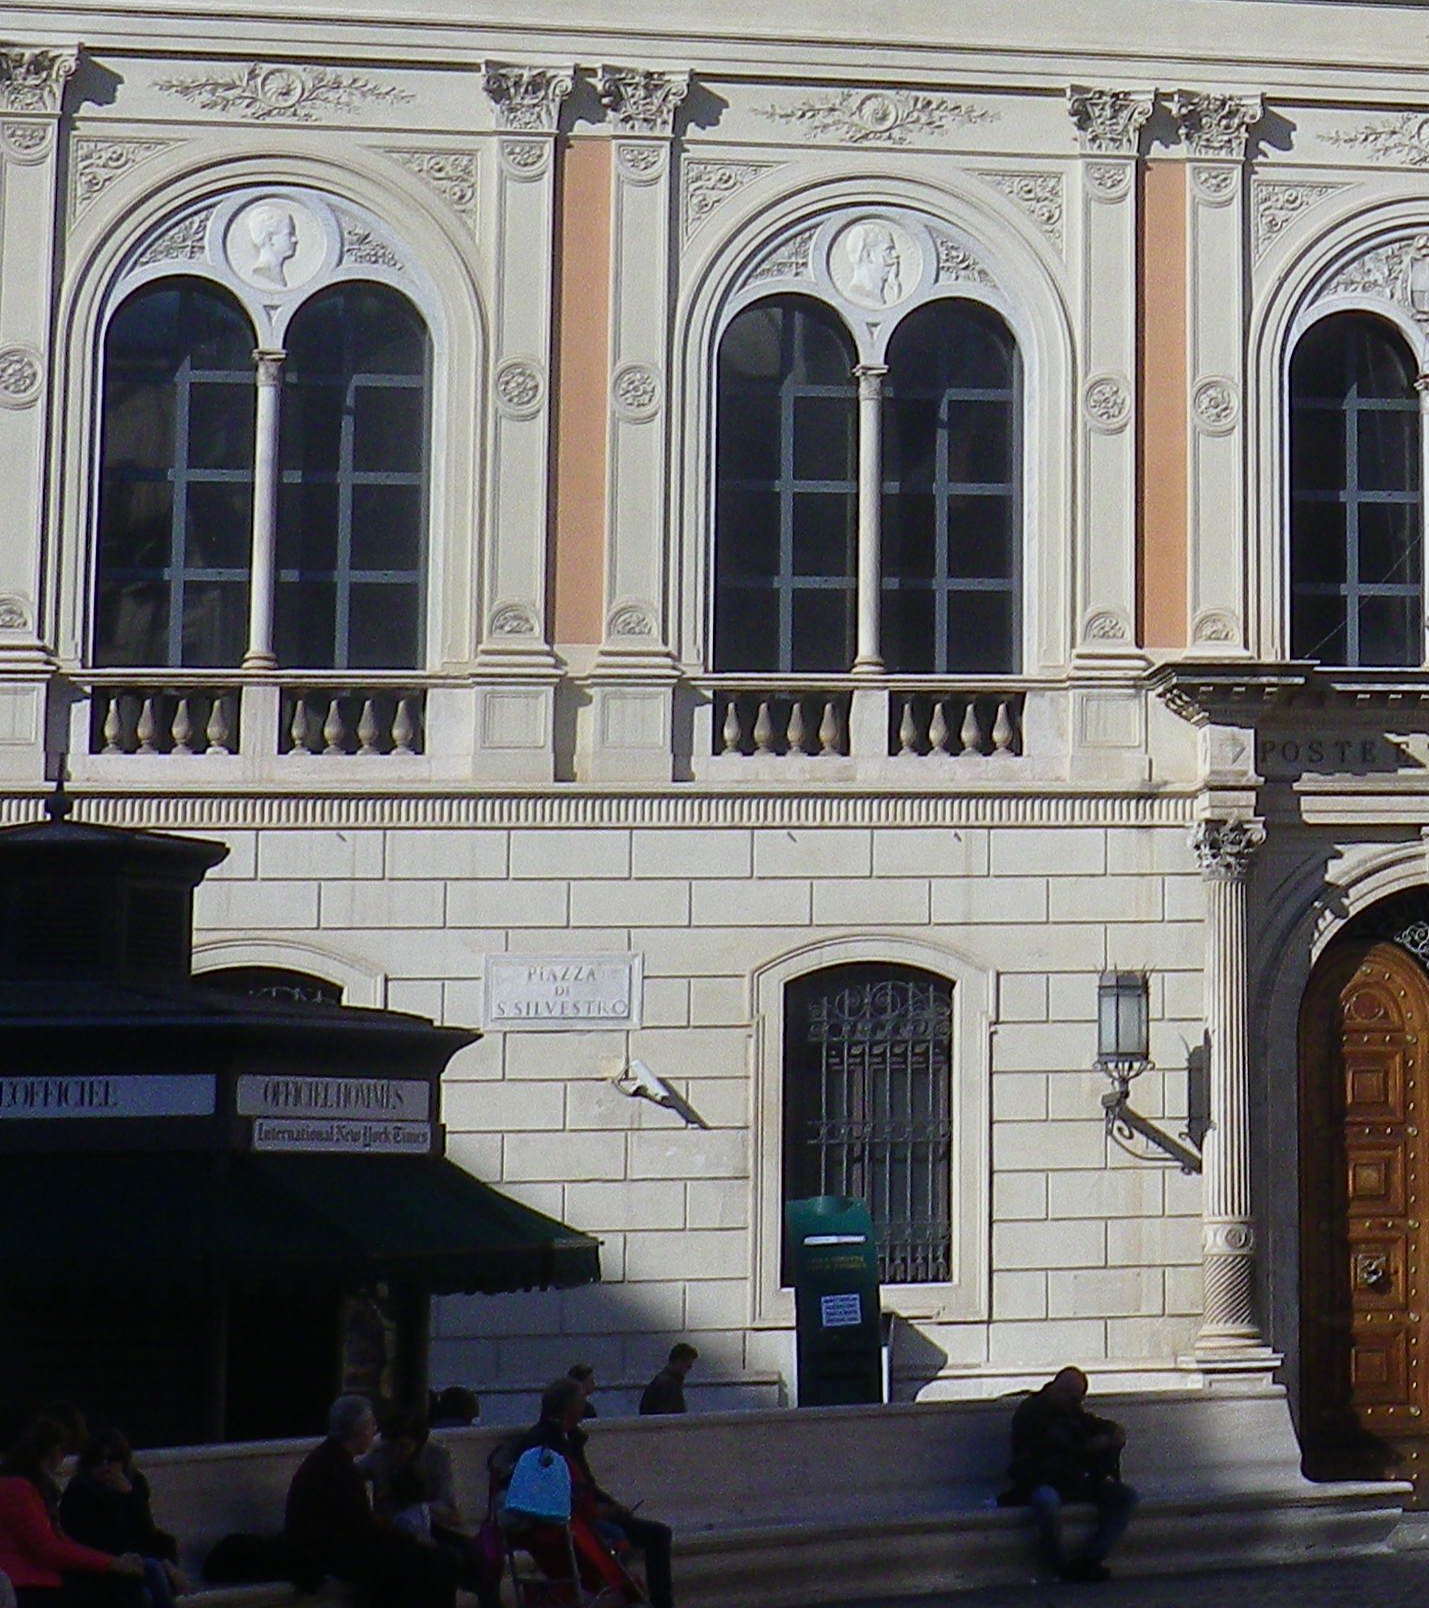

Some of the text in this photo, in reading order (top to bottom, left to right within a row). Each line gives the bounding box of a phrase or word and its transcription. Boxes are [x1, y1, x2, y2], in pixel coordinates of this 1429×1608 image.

[1261, 739, 1377, 764] POSTE
[1393, 740, 1410, 764] E
[527, 965, 597, 982] PIAZZA
[554, 985, 570, 997] DI
[257, 1122, 428, 1148] International New York Times
